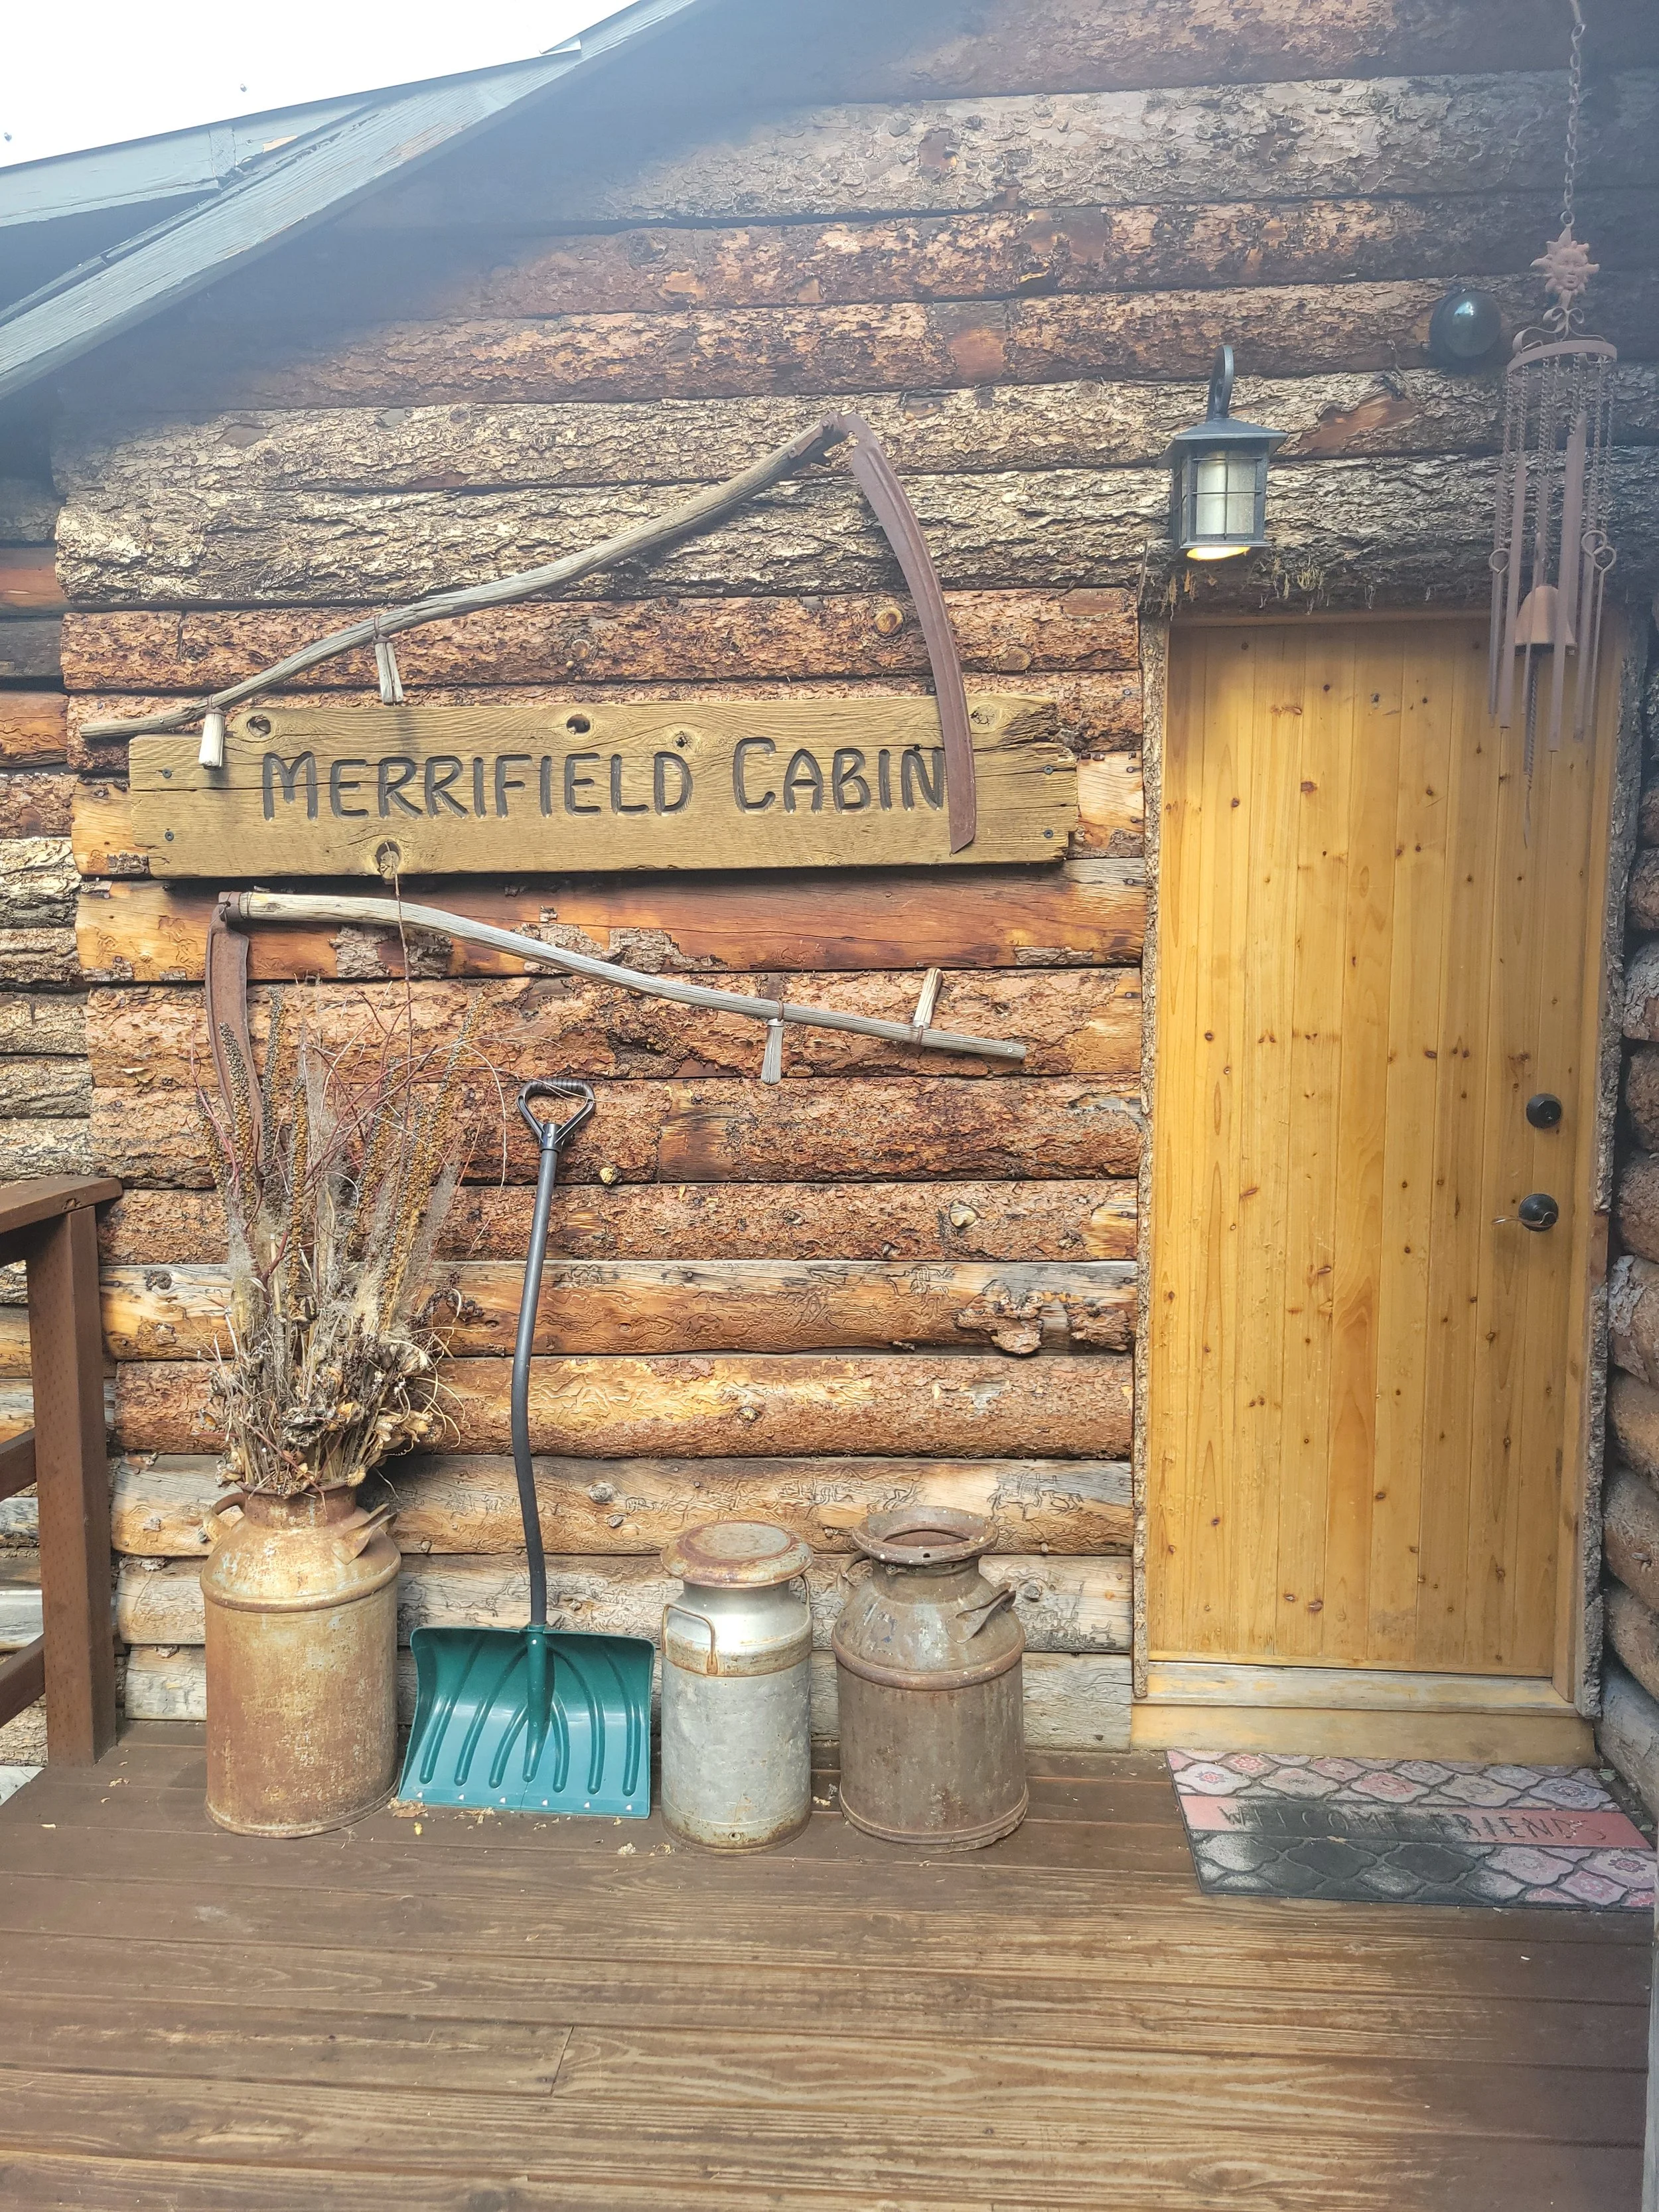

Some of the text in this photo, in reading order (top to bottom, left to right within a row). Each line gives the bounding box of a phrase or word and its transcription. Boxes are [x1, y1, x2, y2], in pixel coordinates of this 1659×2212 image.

[263, 737, 945, 821] MERRIFIELD CABIN
[1429, 1812, 1607, 1841] FRIENDS
